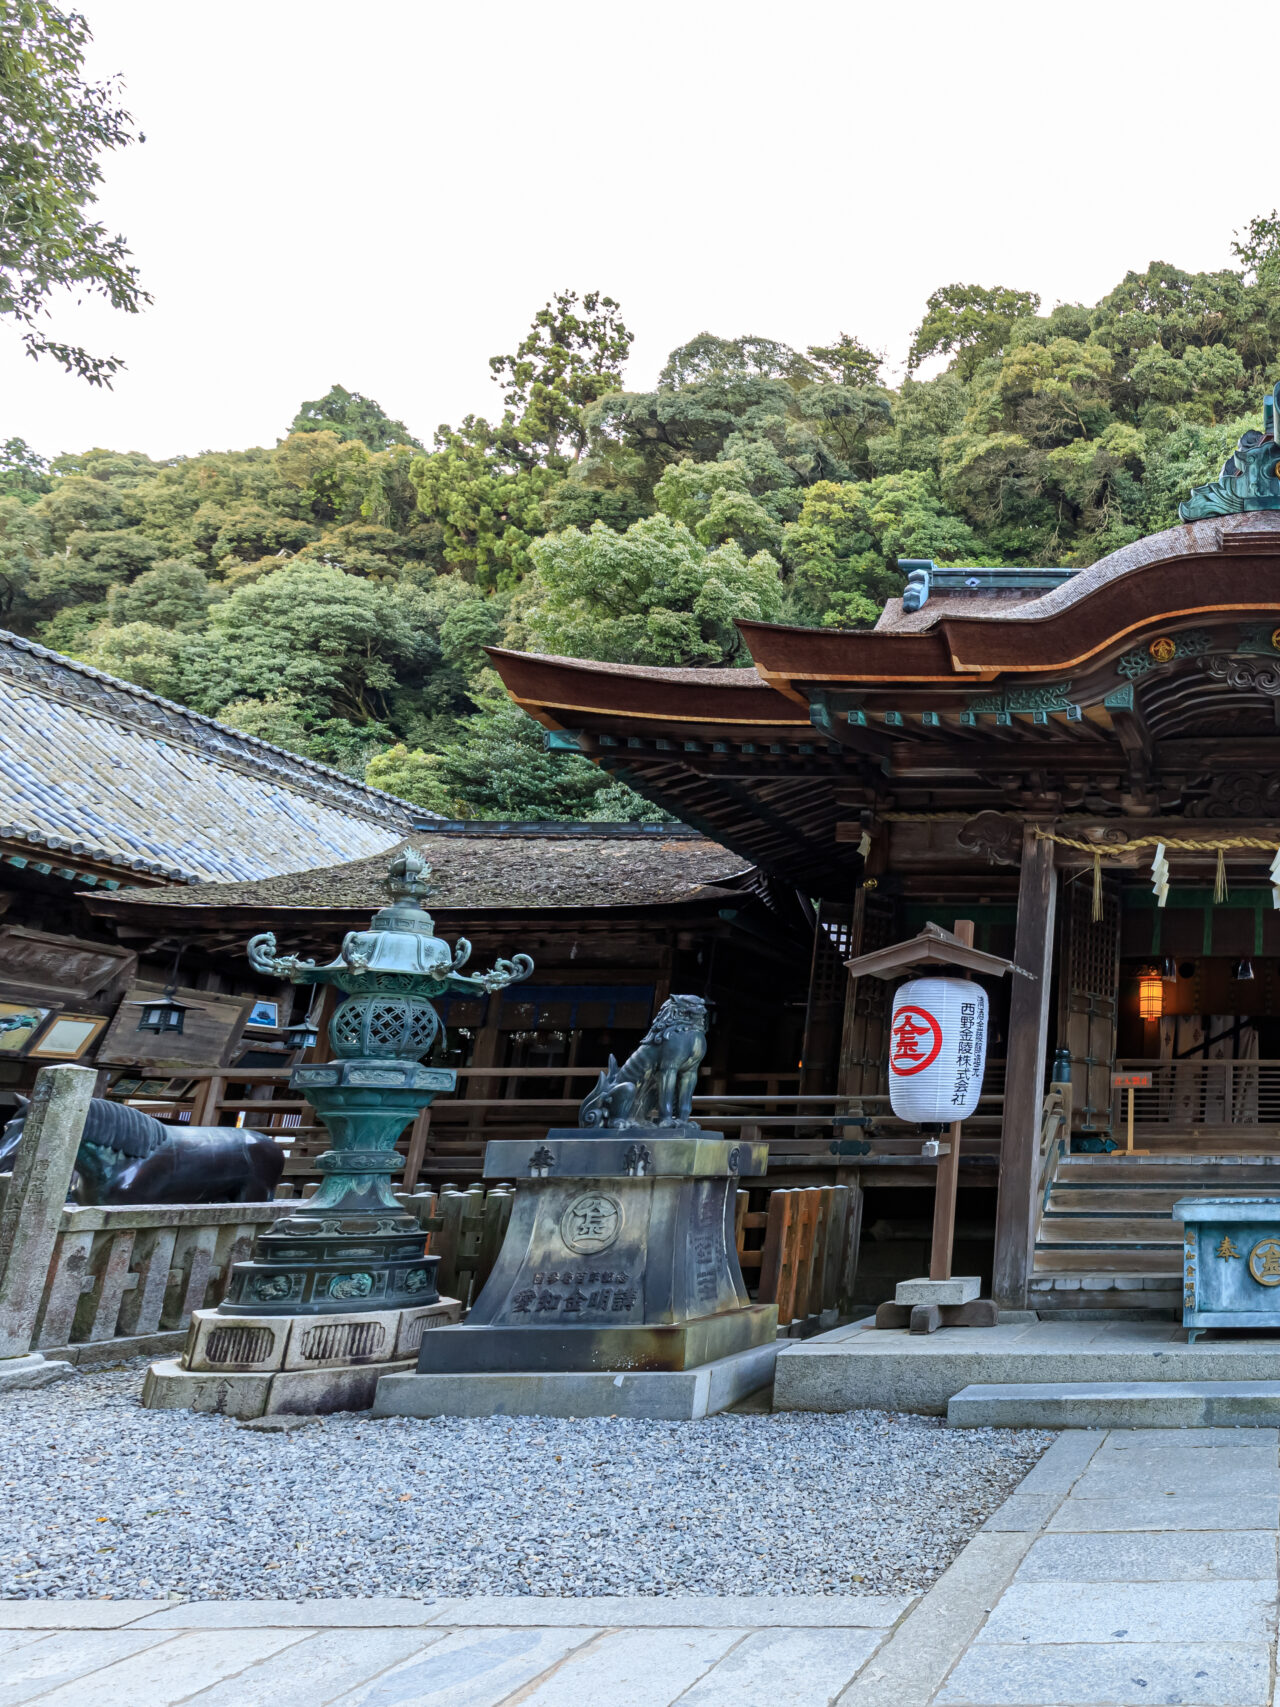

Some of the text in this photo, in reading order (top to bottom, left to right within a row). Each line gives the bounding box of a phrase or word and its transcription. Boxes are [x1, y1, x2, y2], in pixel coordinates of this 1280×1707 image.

[893, 1014, 931, 1062] 金
[951, 1002, 976, 1106] 西野金陵株式会社
[1217, 1235, 1241, 1263] 奉
[511, 1287, 638, 1313] 愛知金明講
